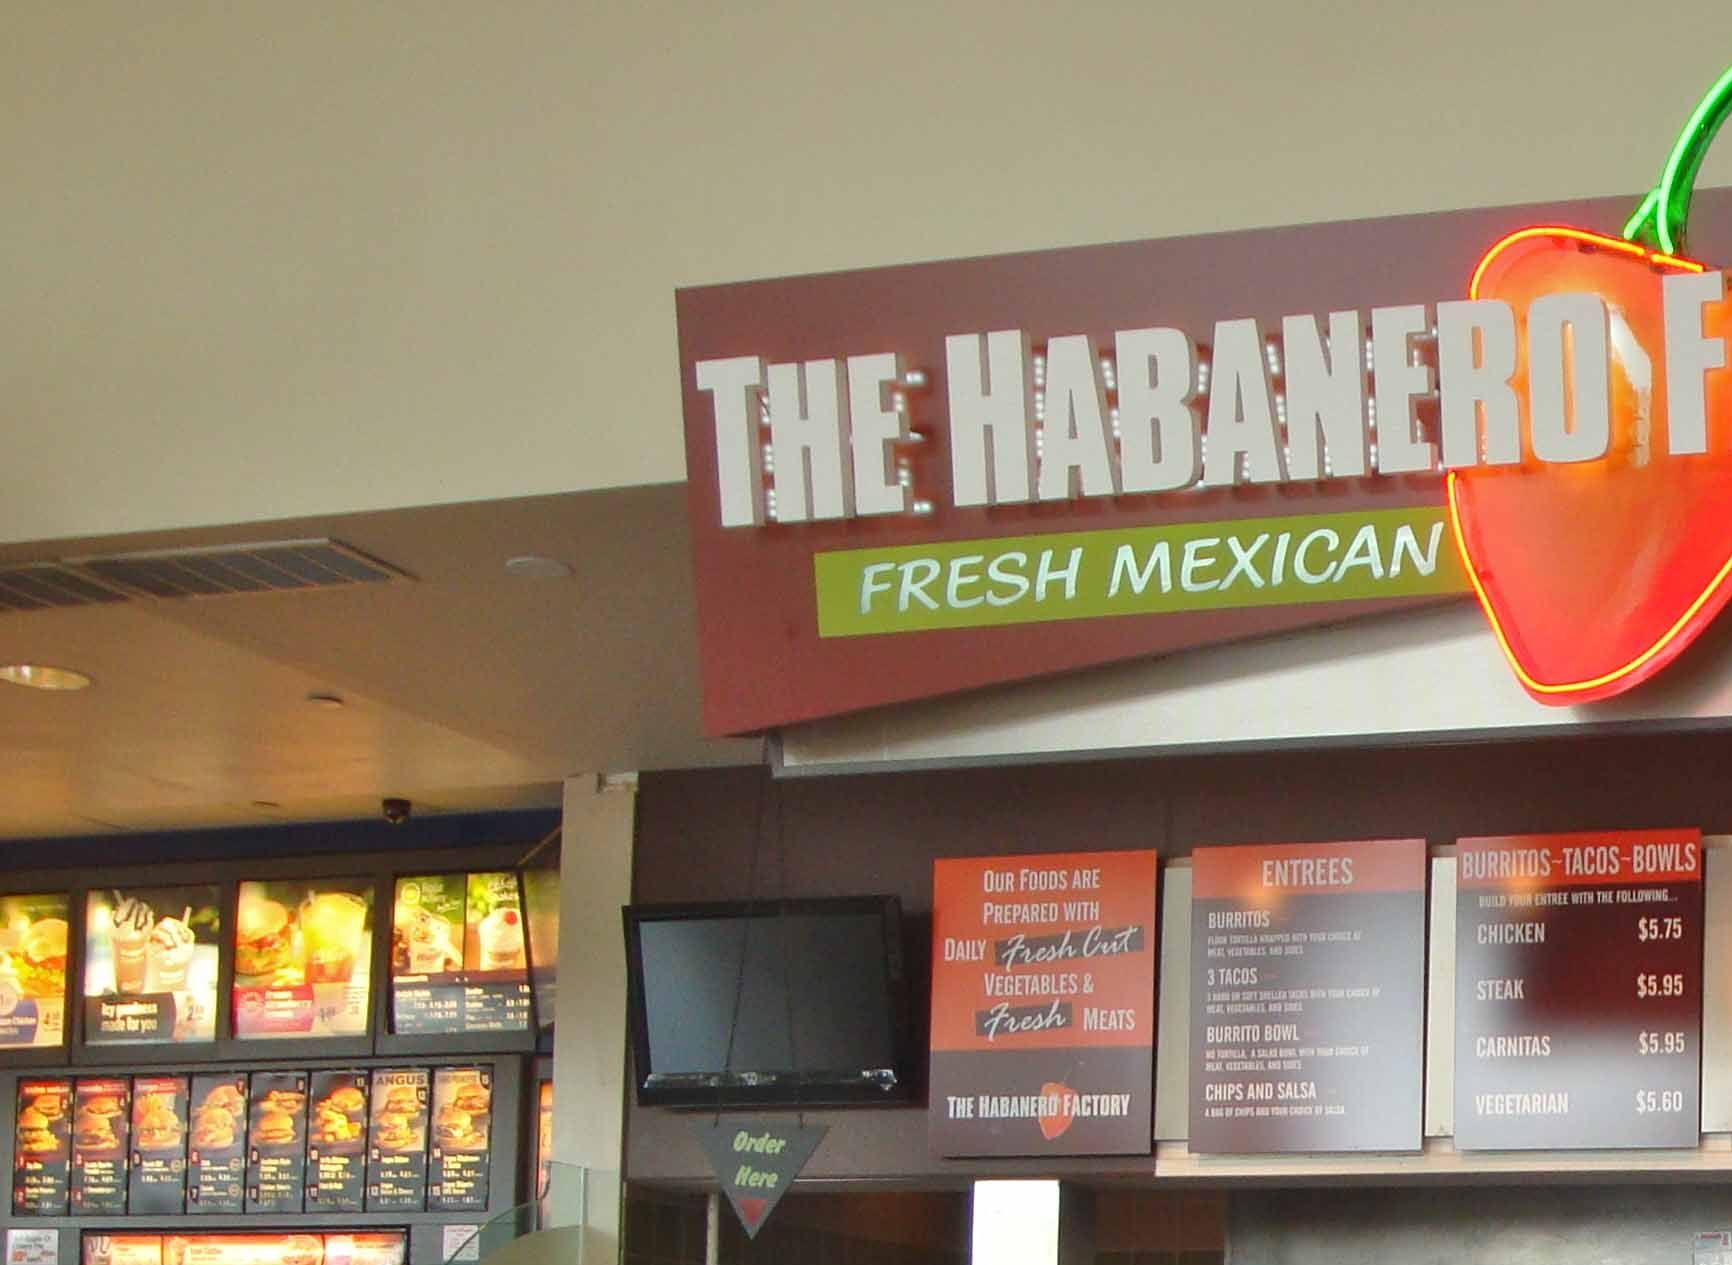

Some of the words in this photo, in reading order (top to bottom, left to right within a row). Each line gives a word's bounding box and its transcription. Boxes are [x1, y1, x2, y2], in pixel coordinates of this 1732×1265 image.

[695, 352, 914, 528] THE
[945, 293, 1613, 508] HABANERO
[859, 547, 1083, 617] FRESH
[1107, 522, 1444, 598] MEXICAN
[984, 870, 1014, 892] OUR
[1019, 867, 1068, 891] FOODS
[1072, 868, 1101, 889] ARE
[1263, 858, 1354, 887] ENTREES
[1535, 893, 1568, 906] ENTREE
[1571, 892, 1594, 904] WITH
[1597, 891, 1613, 904] THE
[983, 903, 1058, 925] PREPARED
[1064, 902, 1099, 922] WITH
[1208, 911, 1270, 928] BURRITOS
[1477, 923, 1545, 944] CHICKEN
[1638, 917, 1682, 942] $5.75
[945, 939, 987, 962] DAILY
[1001, 931, 1078, 971] Fresh
[1082, 926, 1139, 955] Cut
[984, 974, 1078, 997] VEGETABLES
[1083, 974, 1094, 994] &
[1207, 969, 1215, 986] 3
[1218, 967, 1258, 985] TACOS
[1477, 979, 1524, 1000] STEAK
[1637, 974, 1683, 998] $5.95
[984, 1002, 1066, 1041] Fresh
[1083, 1008, 1135, 1031] MEATS
[1207, 1025, 1260, 1043] BURRITO
[1264, 1024, 1300, 1042] BOWL
[1476, 1036, 1551, 1057] CARNITAS
[1639, 1032, 1685, 1054] $5.95
[376, 1074, 425, 1086] ANGUS
[1205, 1084, 1244, 1101] CHIPS
[1249, 1083, 1273, 1100] AND
[1278, 1082, 1316, 1099] SALSA
[947, 1096, 974, 1119] THE
[979, 1095, 1059, 1118] HABANERO
[1063, 1094, 1131, 1118] FACTORY
[1476, 1093, 1569, 1115] VEGETARIAN
[1636, 1090, 1683, 1114] $5.60
[733, 1130, 786, 1154] Order
[735, 1165, 779, 1188] Here
